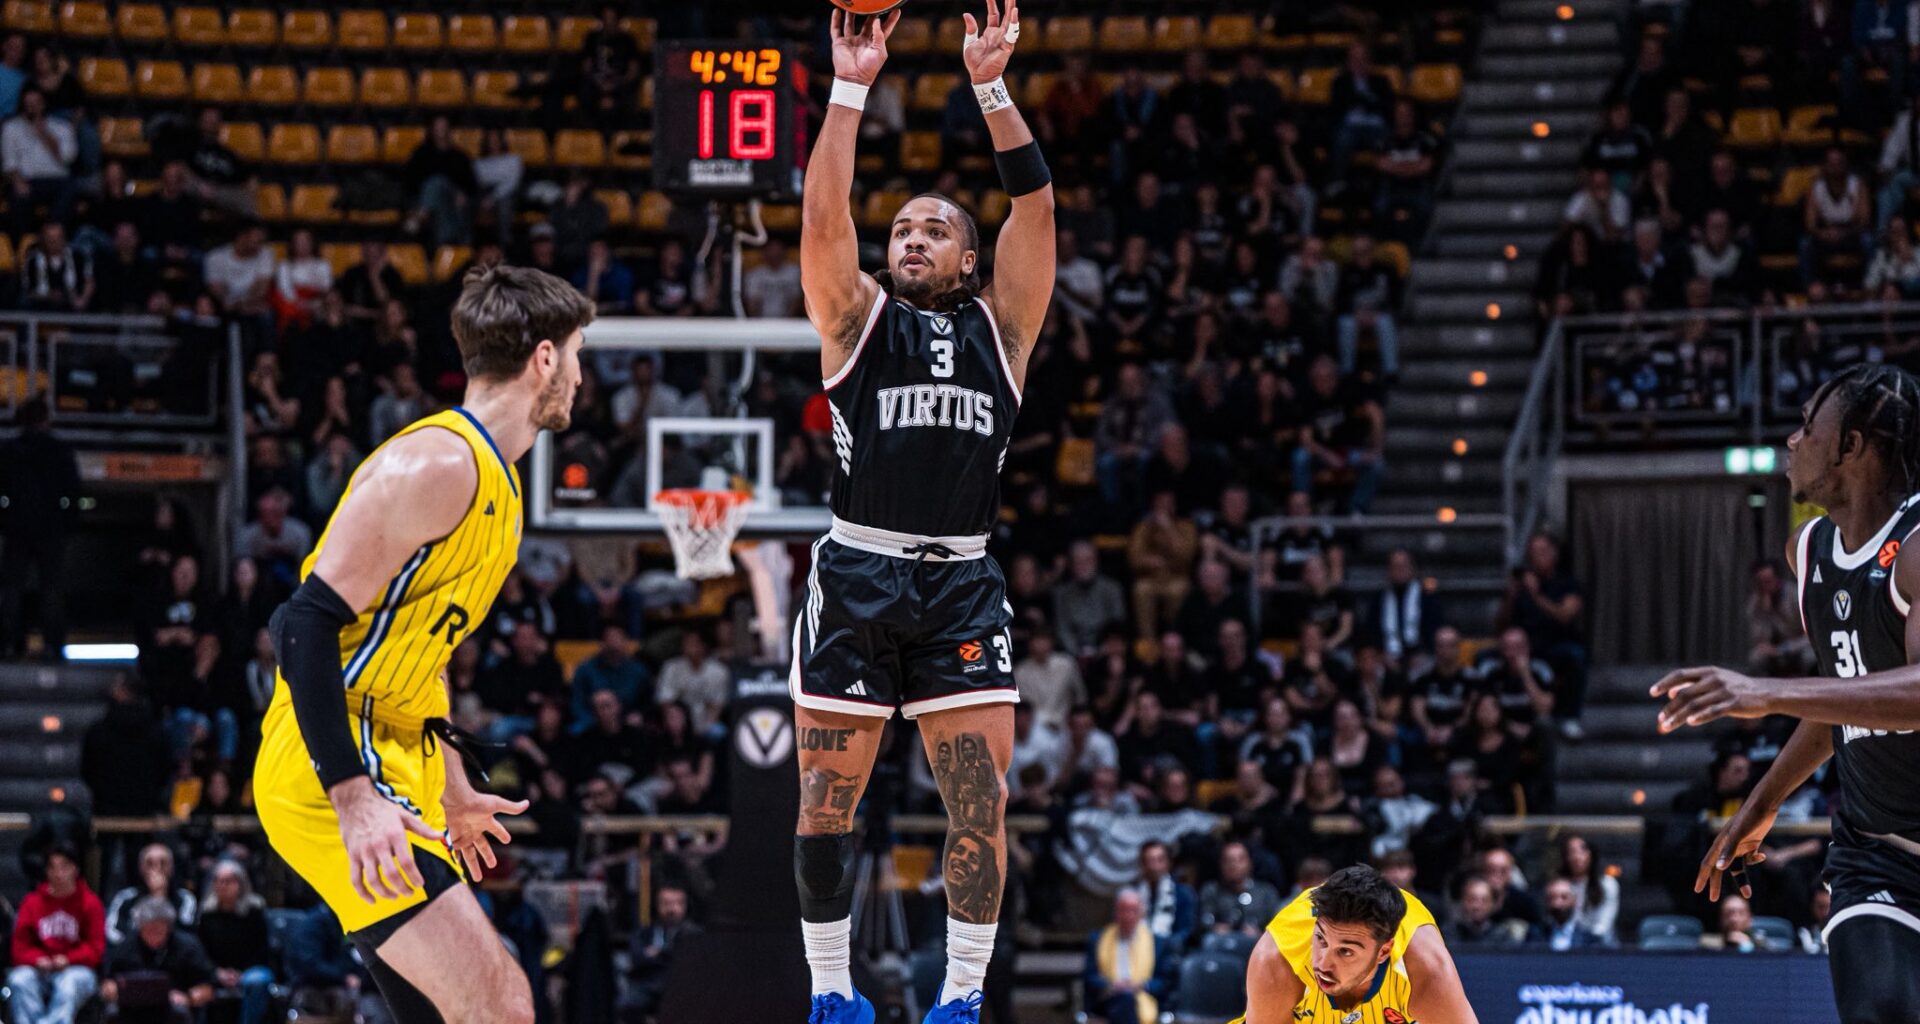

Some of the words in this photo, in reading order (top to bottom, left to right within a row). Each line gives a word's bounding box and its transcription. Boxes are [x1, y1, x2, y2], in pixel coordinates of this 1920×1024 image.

[690, 49, 781, 86] 4:42
[698, 89, 776, 159] 18
[930, 339, 954, 378] 3
[877, 383, 994, 436] VIRTUS
[1830, 629, 1868, 678] 31
